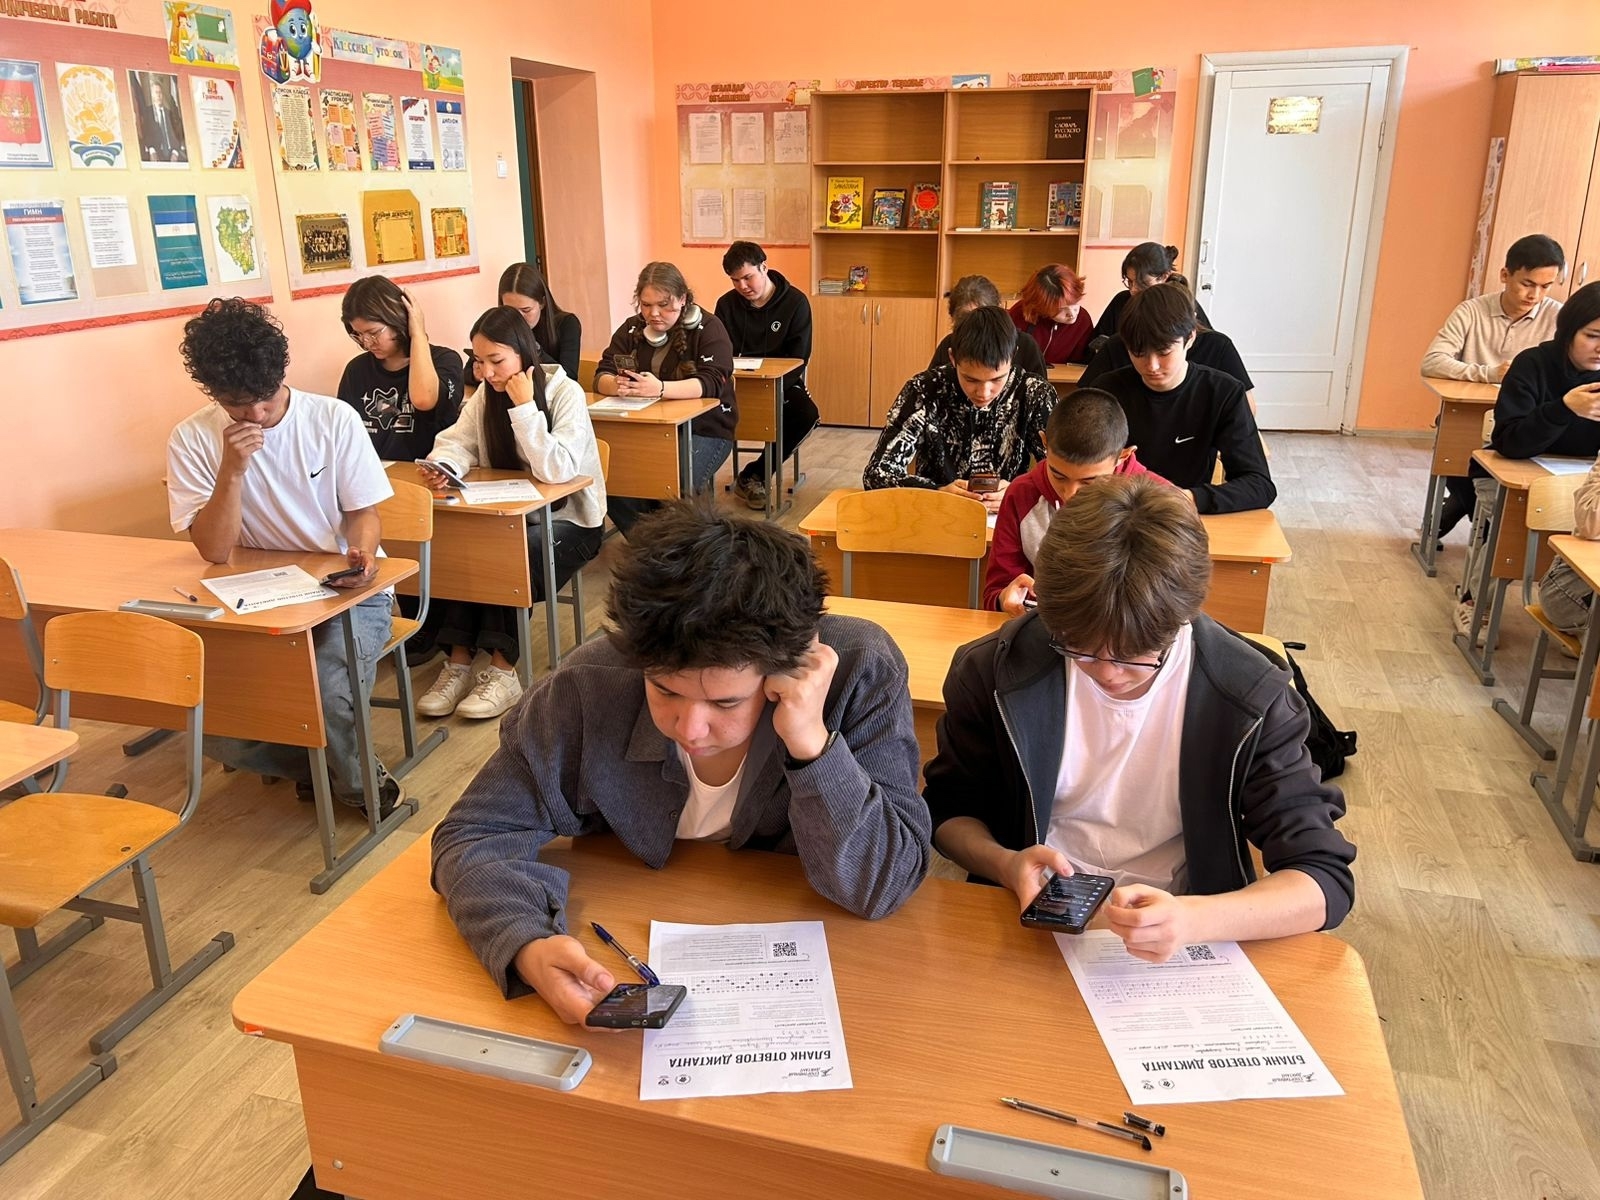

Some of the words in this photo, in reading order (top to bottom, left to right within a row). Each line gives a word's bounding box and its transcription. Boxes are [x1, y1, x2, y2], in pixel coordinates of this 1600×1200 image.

[75, 9, 117, 28] РАБОТА
[669, 1053, 732, 1068] ДИКТАНТА
[735, 1051, 787, 1064] ОТВЕТОВ
[790, 1050, 831, 1060] БЛАНК
[1262, 1055, 1306, 1066] БЛАНК
[1142, 1058, 1204, 1072] ДИКТАНТА
[1208, 1057, 1261, 1069] ОТВЕТОВ
